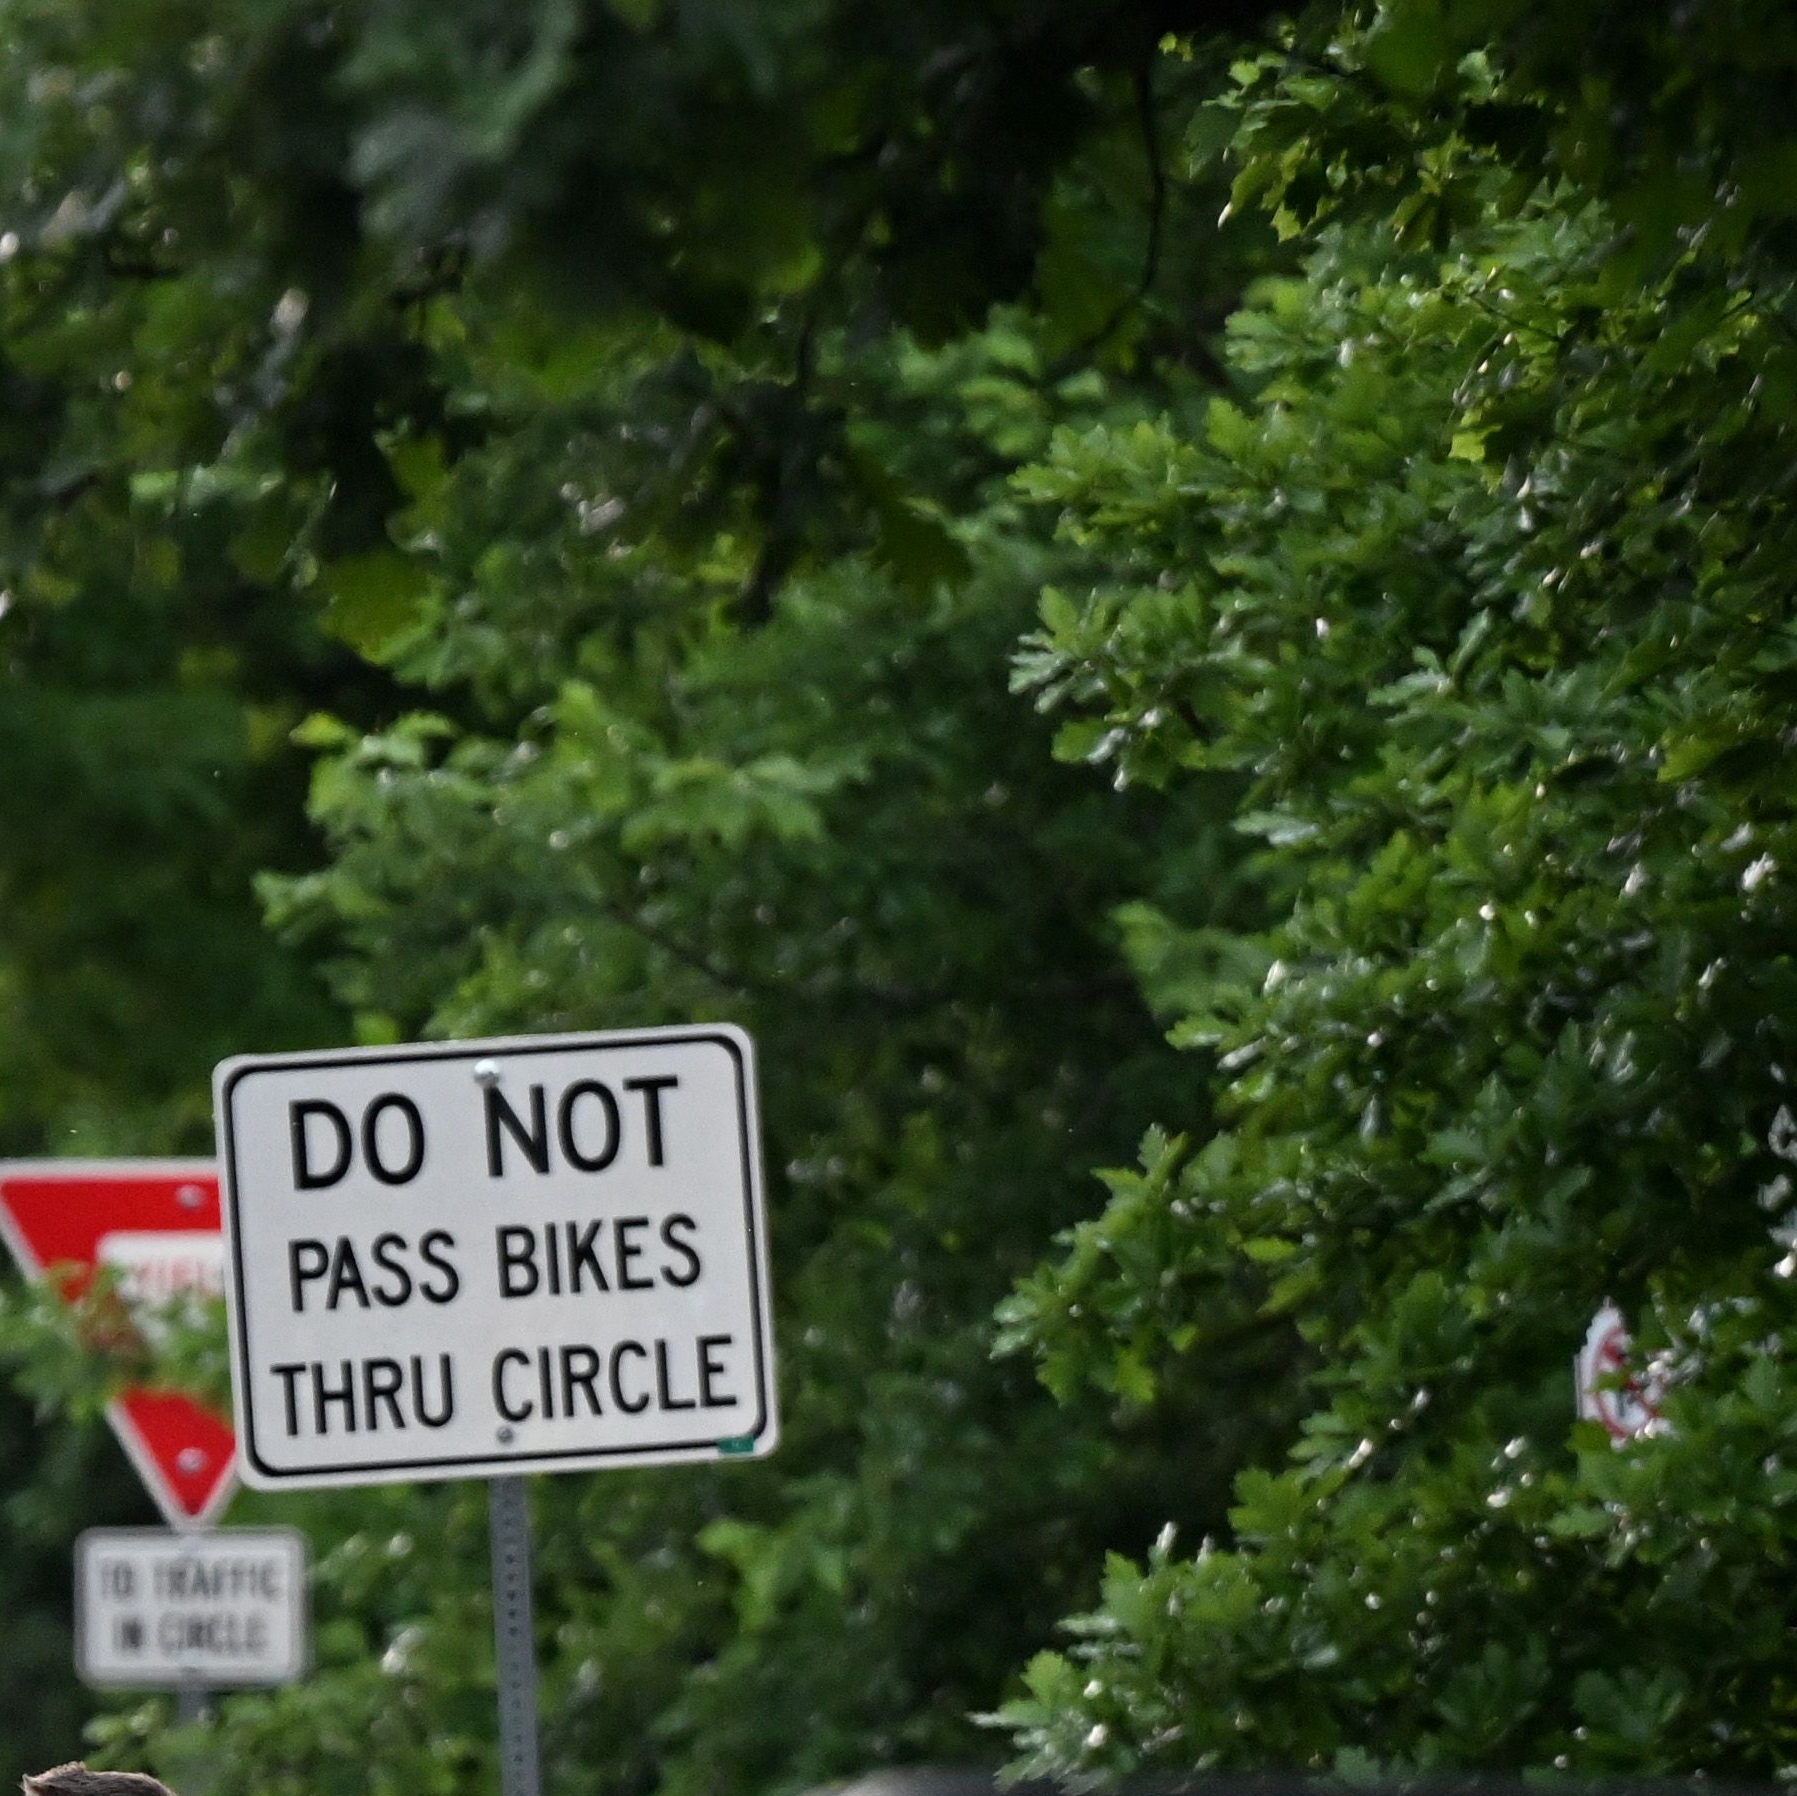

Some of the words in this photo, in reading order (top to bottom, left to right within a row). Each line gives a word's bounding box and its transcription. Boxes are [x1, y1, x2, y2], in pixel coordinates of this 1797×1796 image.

[287, 1091, 426, 1192] DO
[482, 1074, 680, 1179] NOT
[287, 1229, 461, 1313] PASS
[495, 1212, 702, 1300] BIKES
[269, 1352, 456, 1437] THRU
[490, 1334, 738, 1424] CIRCLE
